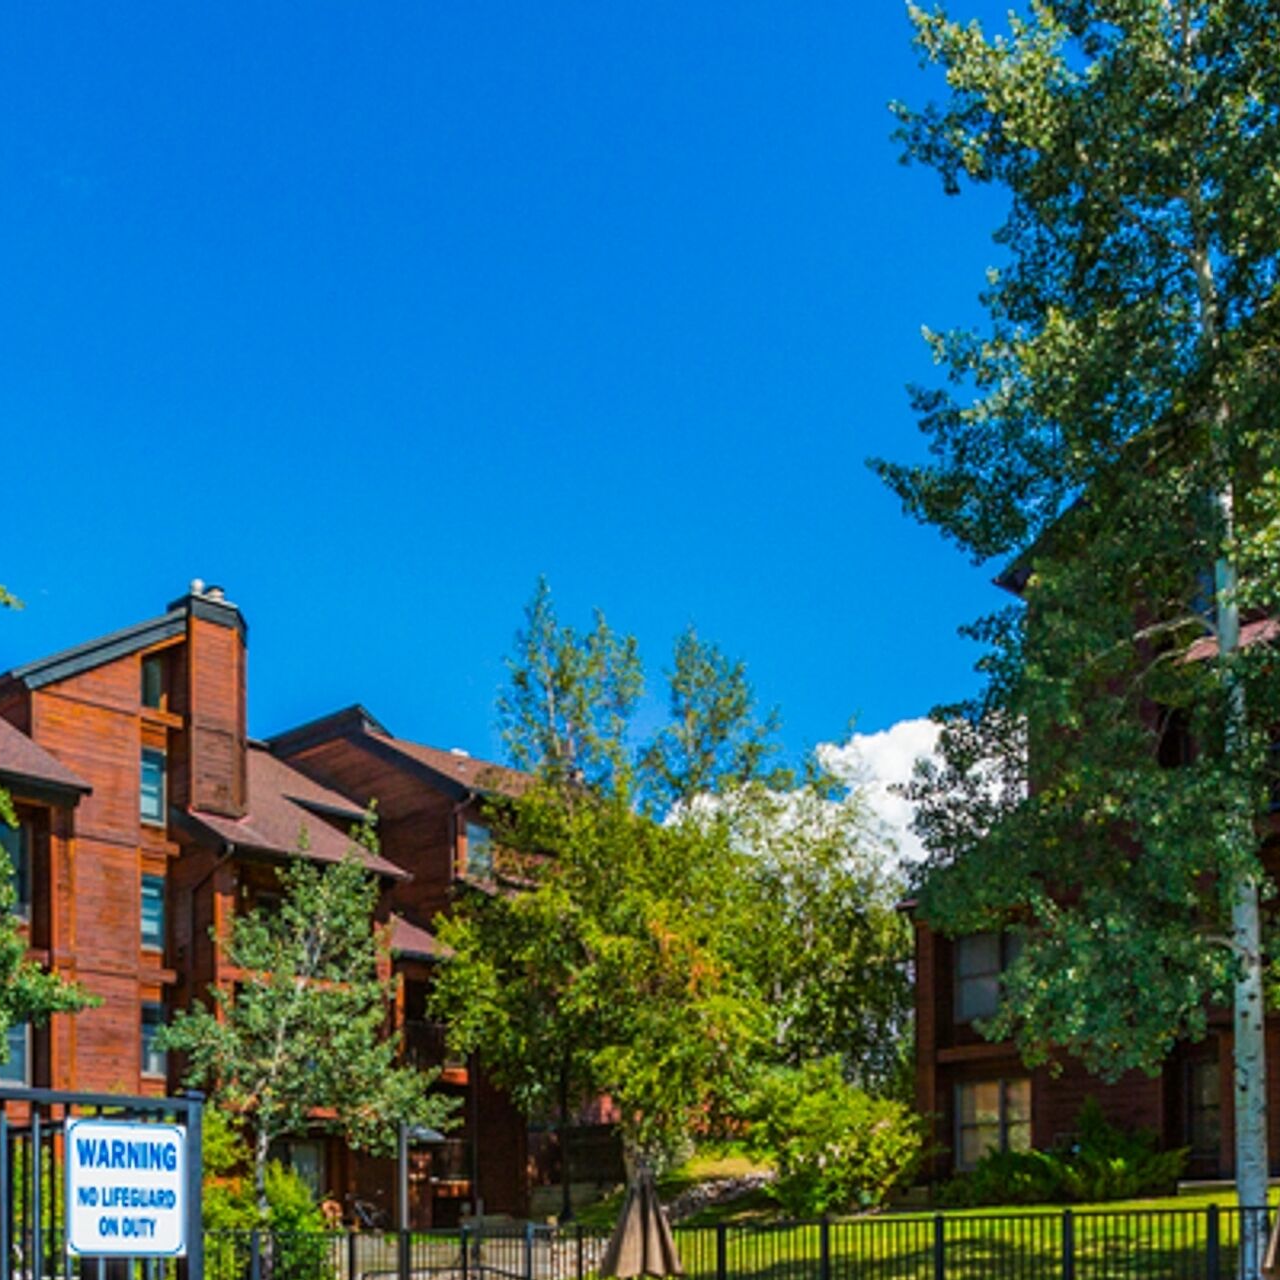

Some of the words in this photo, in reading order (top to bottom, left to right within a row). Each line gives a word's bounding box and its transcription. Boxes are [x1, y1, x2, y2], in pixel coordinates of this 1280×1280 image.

[76, 1139, 176, 1171] WARNING
[78, 1186, 97, 1207] NO
[101, 1187, 176, 1209] LIFEGUARD
[99, 1216, 119, 1236] ON
[122, 1216, 156, 1237] DUTY
